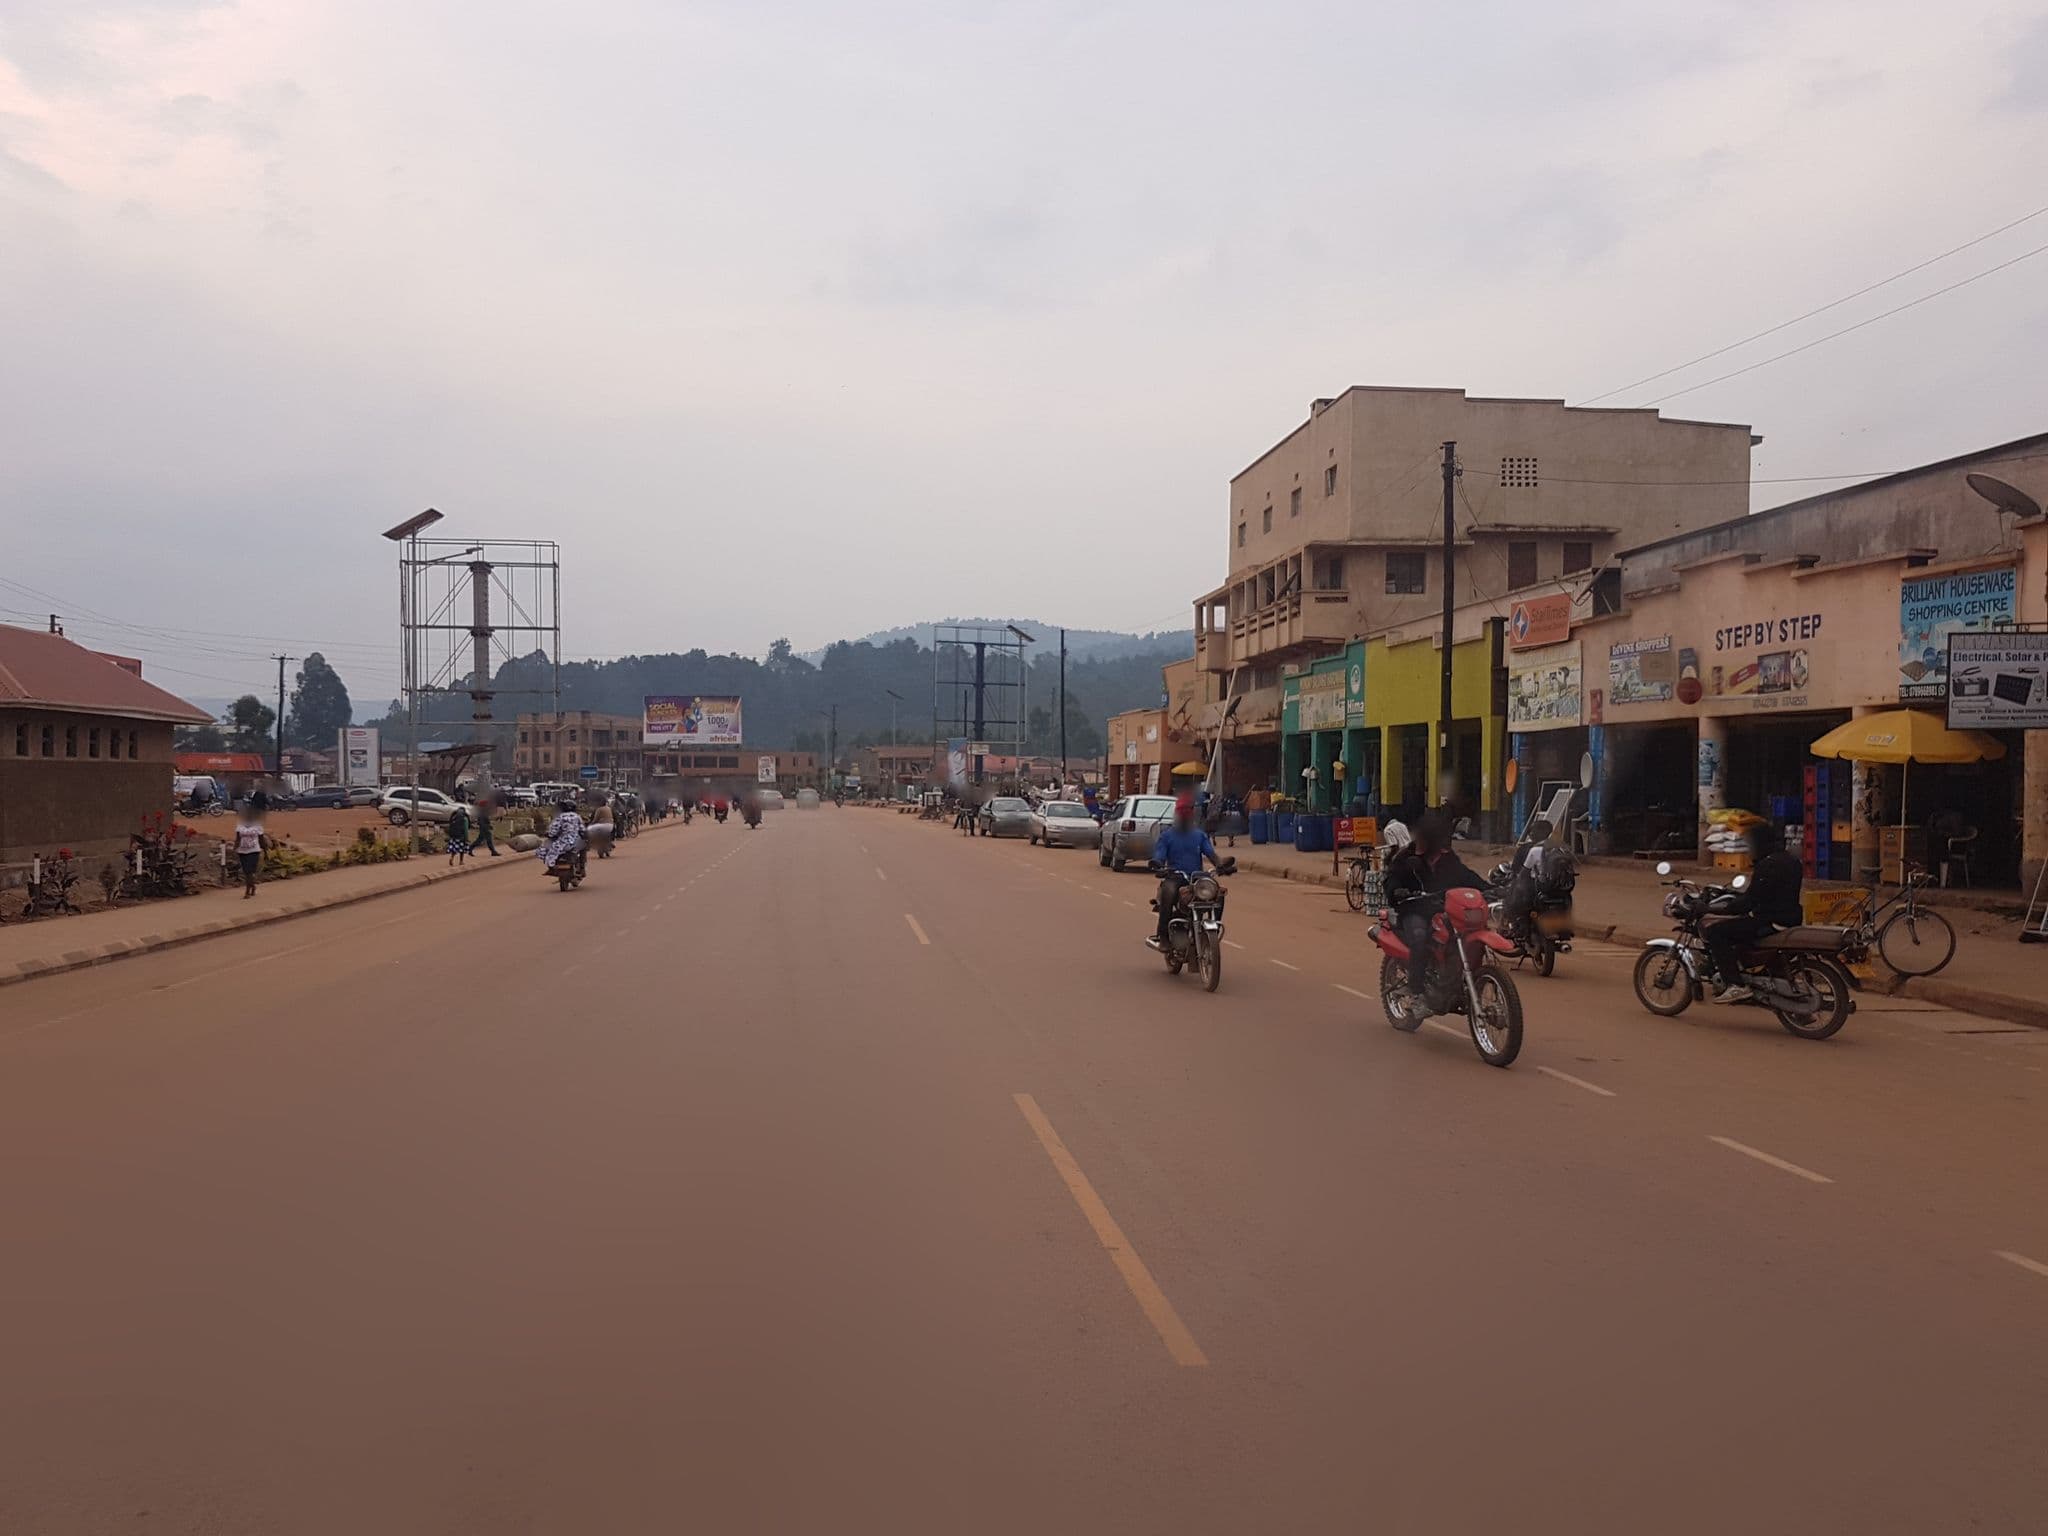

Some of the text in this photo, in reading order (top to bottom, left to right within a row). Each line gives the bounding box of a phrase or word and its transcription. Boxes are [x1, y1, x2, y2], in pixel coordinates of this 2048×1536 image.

[1901, 571, 2015, 604] BRILLIANT HOUSEWARE
[1908, 597, 2009, 622] SHOPPING CENTRE
[1715, 614, 1822, 651] STEP BY STEP
[2005, 651, 2031, 662] Solar
[2033, 653, 2040, 662] &
[1347, 699, 1364, 714] Hima
[709, 735, 738, 743] africell
